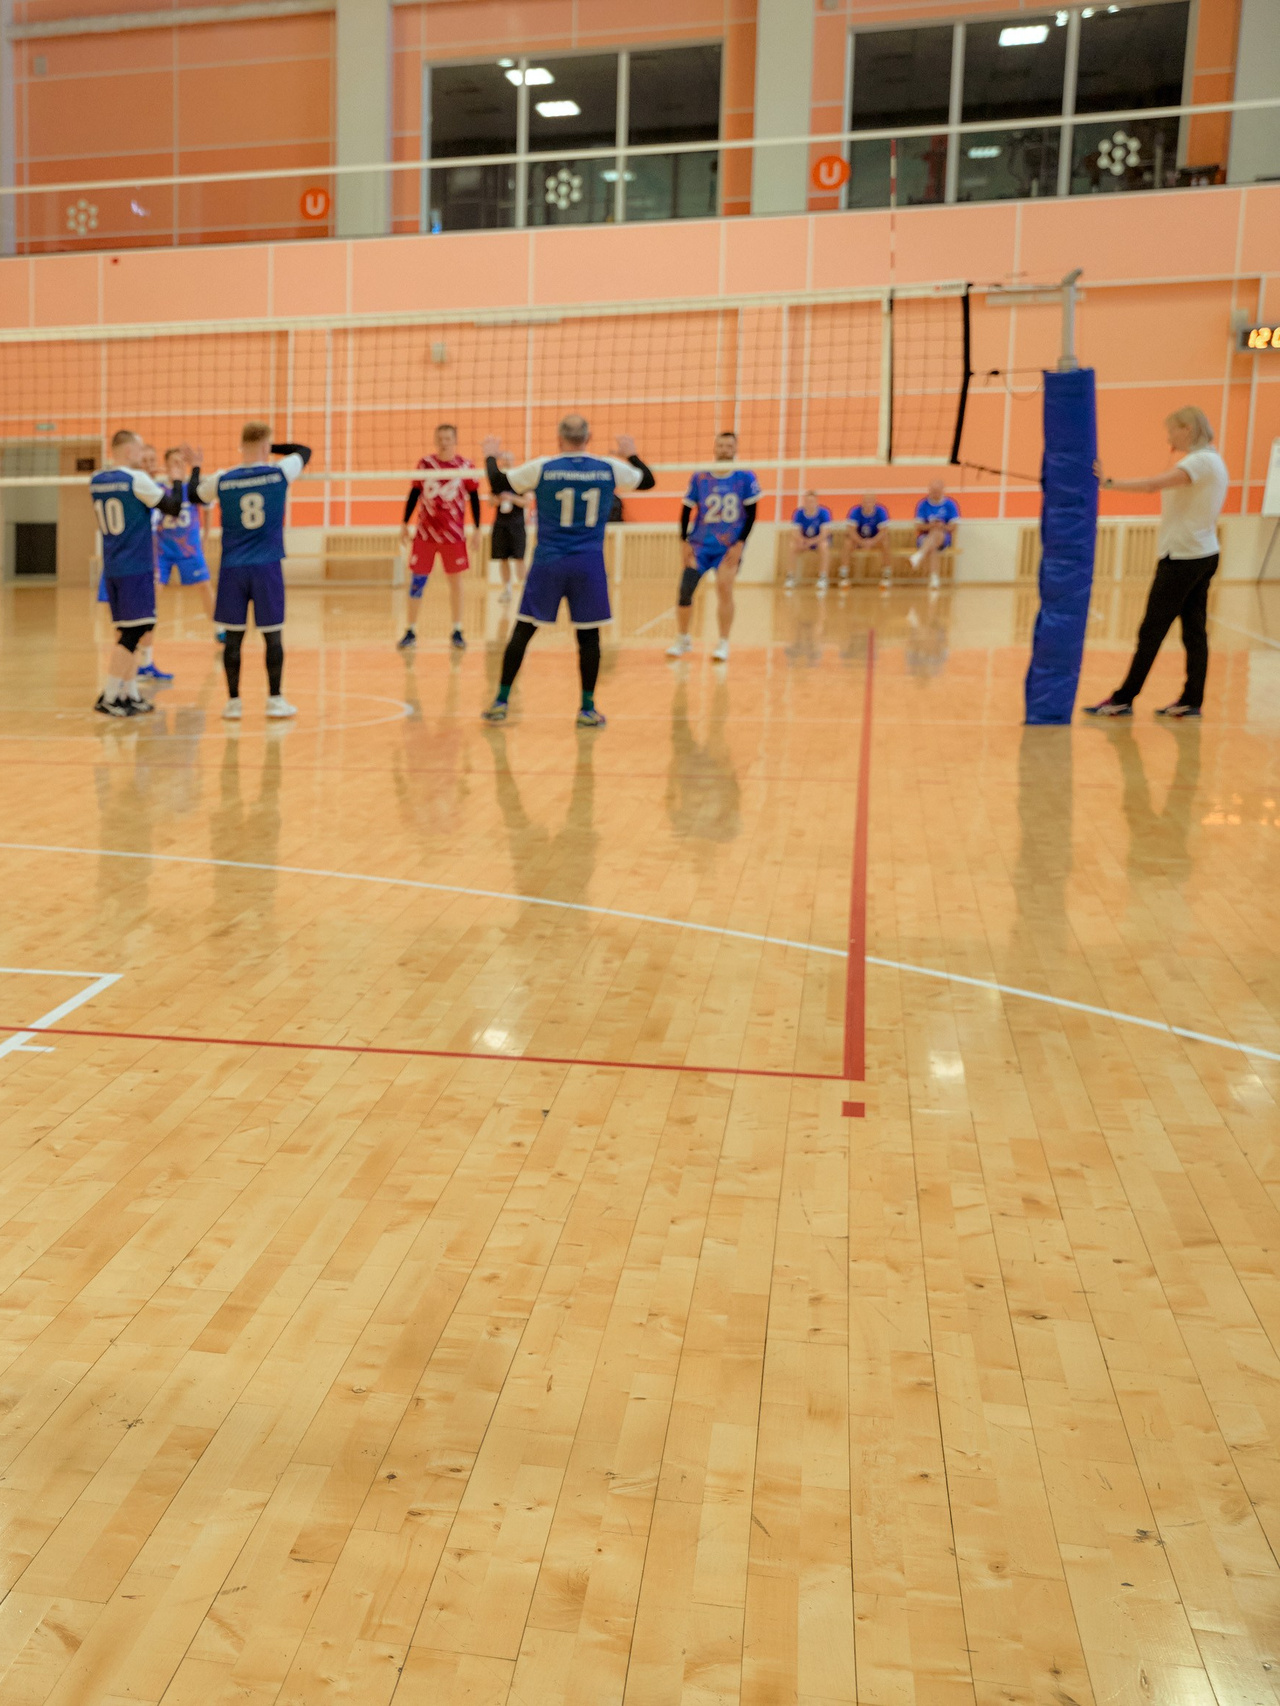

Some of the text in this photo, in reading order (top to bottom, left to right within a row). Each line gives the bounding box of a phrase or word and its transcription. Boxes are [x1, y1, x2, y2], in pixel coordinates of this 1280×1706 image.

[820, 161, 841, 186] U
[306, 194, 325, 216] U
[94, 497, 125, 536] 10
[240, 492, 266, 530] 8
[554, 487, 601, 528] 11
[704, 493, 739, 523] 28
